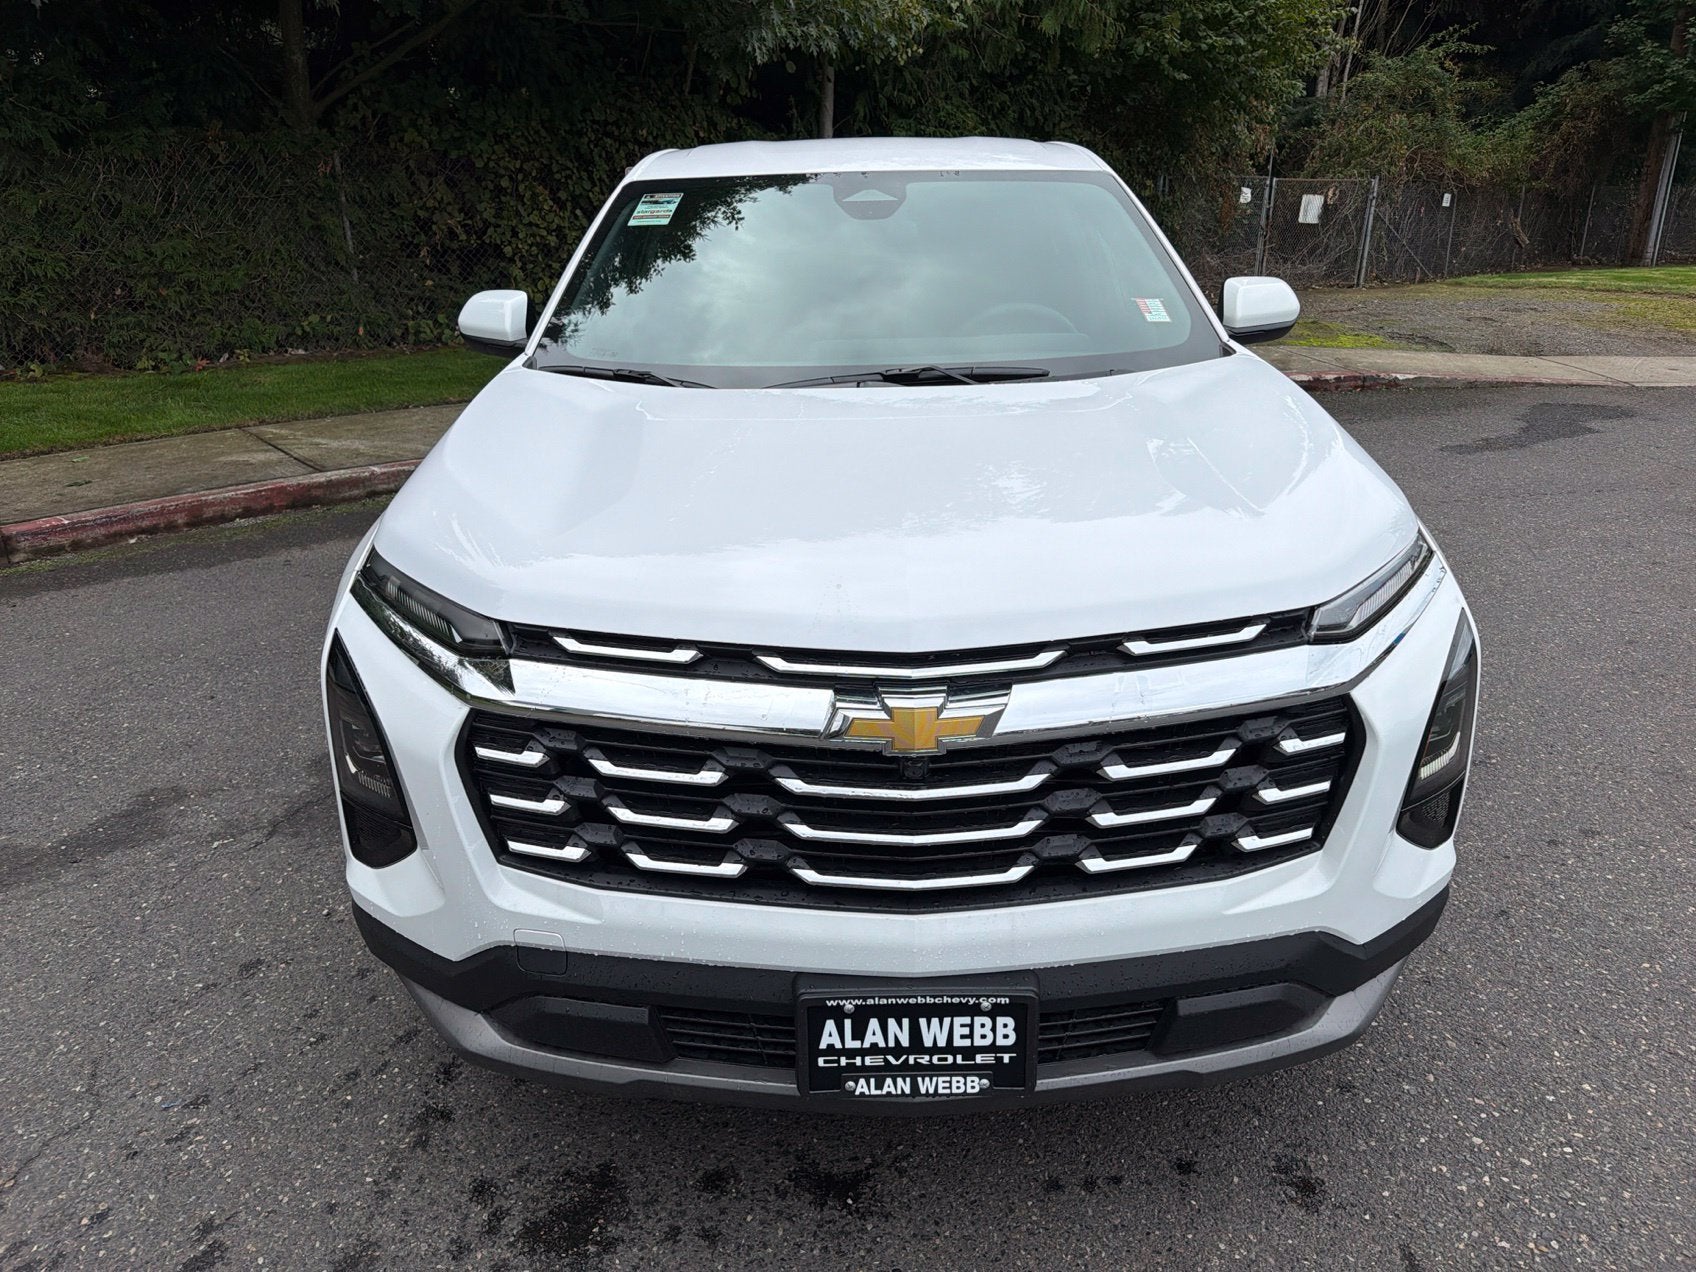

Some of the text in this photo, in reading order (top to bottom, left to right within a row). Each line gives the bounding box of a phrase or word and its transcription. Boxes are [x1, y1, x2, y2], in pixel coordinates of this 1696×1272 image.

[826, 996, 1010, 1007] www.alanwebbchevy.com
[818, 1016, 1017, 1050] ALAN WEBB
[817, 1053, 1017, 1067] CHEVROLET
[854, 1076, 981, 1095] ALAN WEBB
